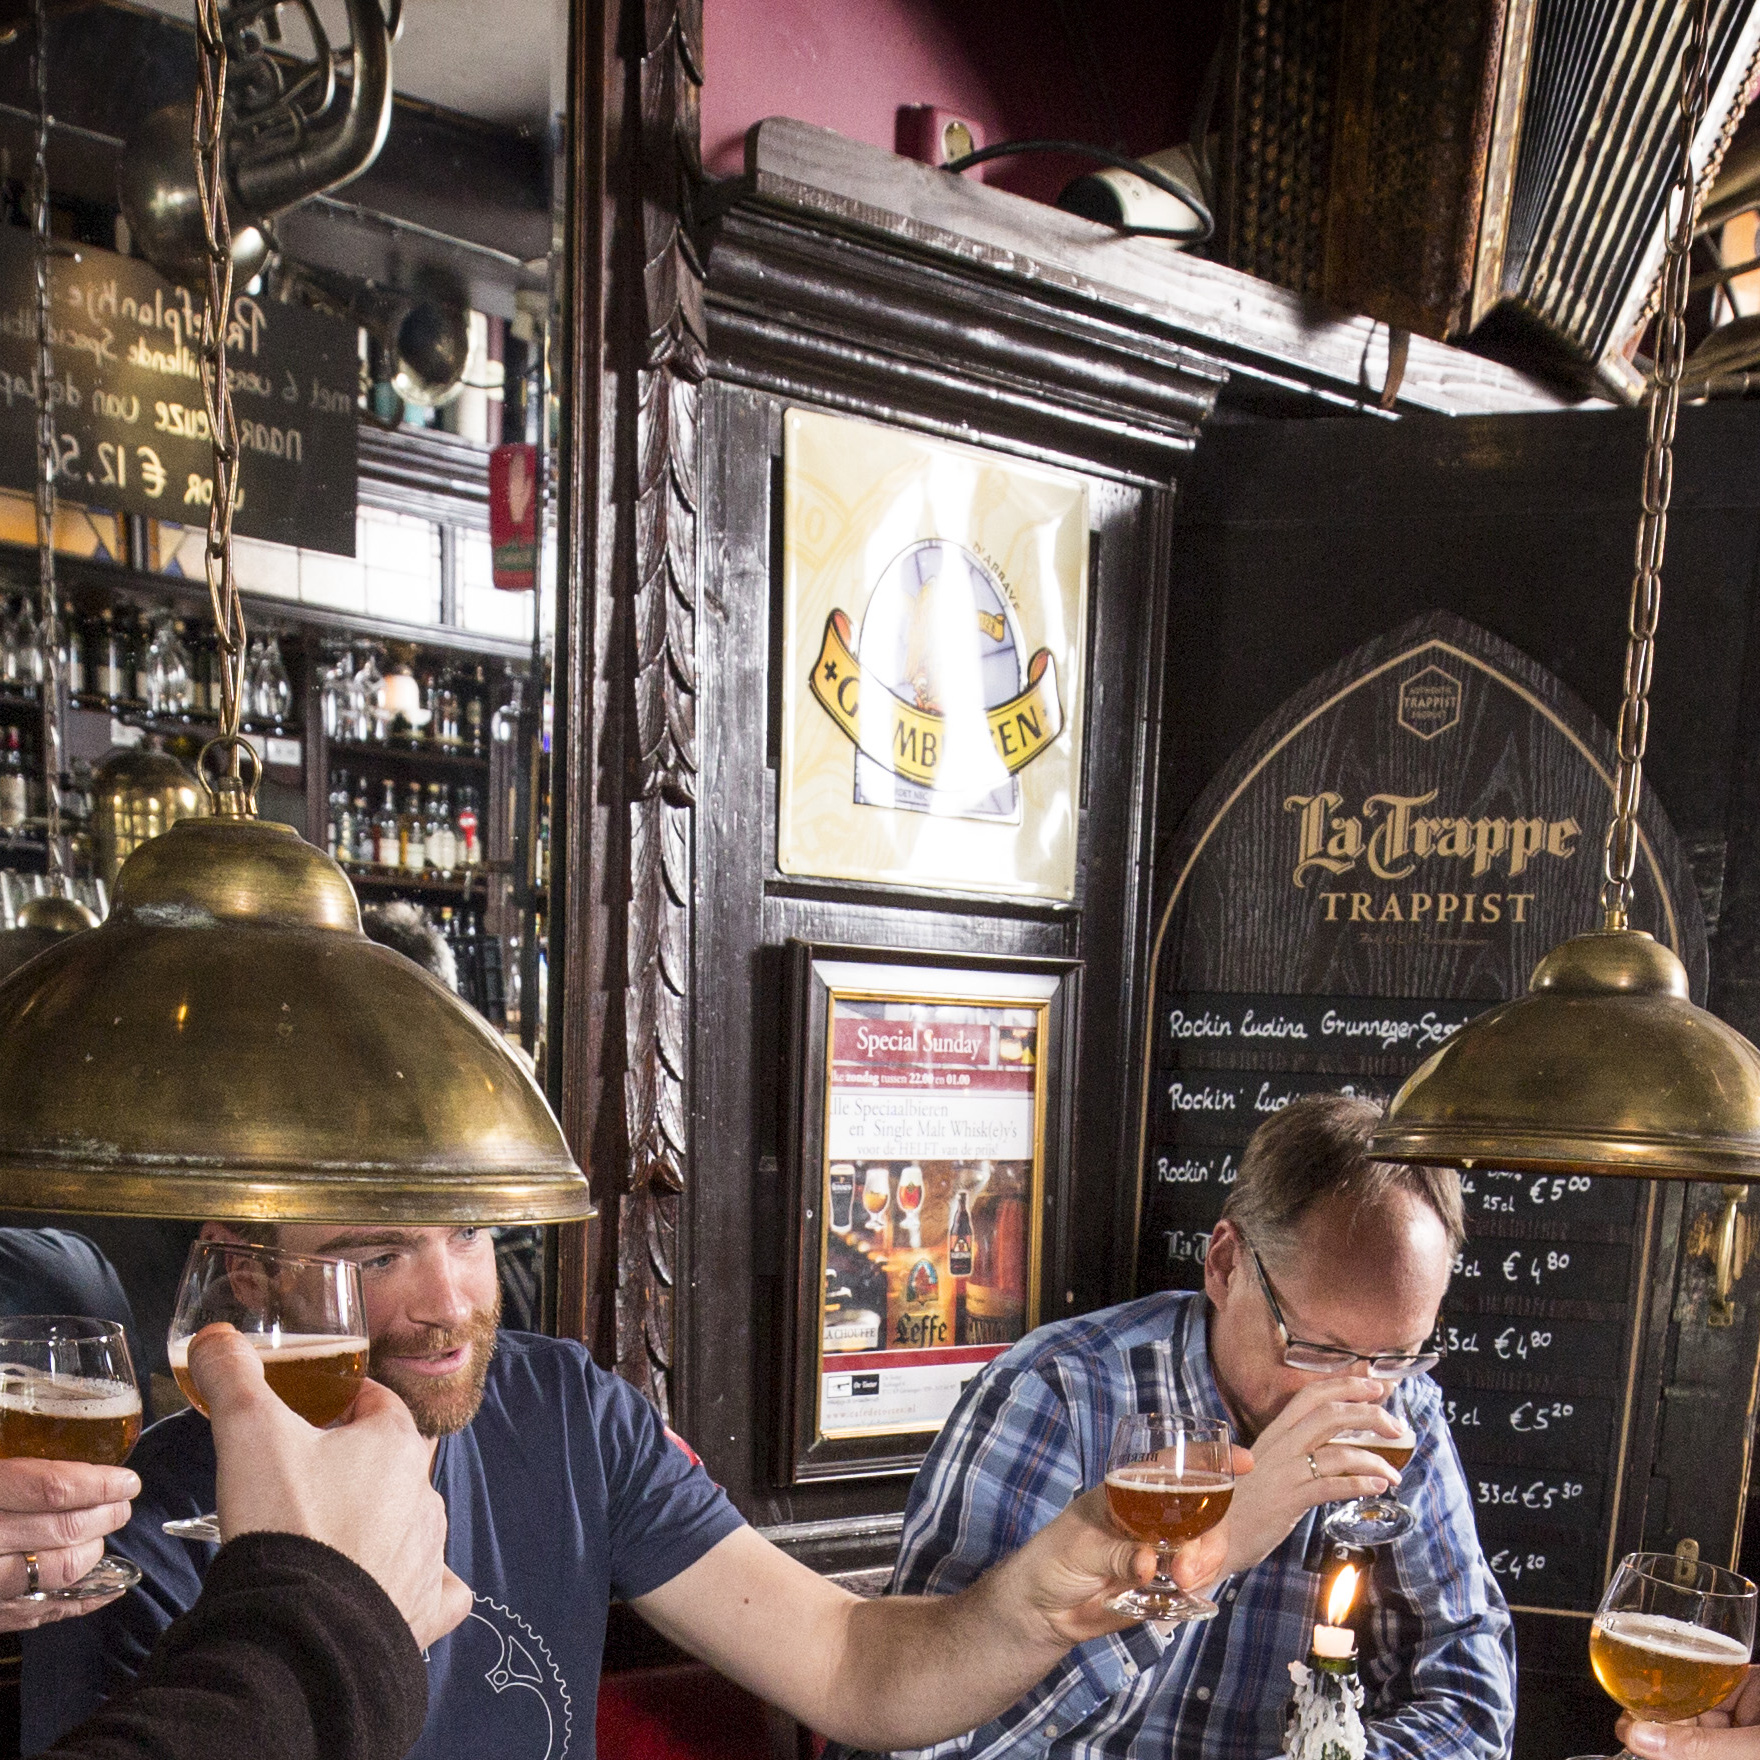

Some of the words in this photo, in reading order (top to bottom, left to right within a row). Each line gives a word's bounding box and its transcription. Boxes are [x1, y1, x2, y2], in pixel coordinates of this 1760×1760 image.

[1318, 891, 1536, 923] TRAPPIST
[857, 1026, 918, 1057] Special
[923, 1030, 982, 1060] Sunday
[845, 1071, 880, 1086] zondag
[946, 1074, 971, 1086] 01.00
[854, 1097, 949, 1121] Speciaalbieren
[849, 1124, 865, 1137] en
[873, 1120, 912, 1142] Single
[917, 1121, 946, 1138] Malt
[950, 1121, 1017, 1142] Whisk(e)y's
[893, 1312, 948, 1347] Leffe
